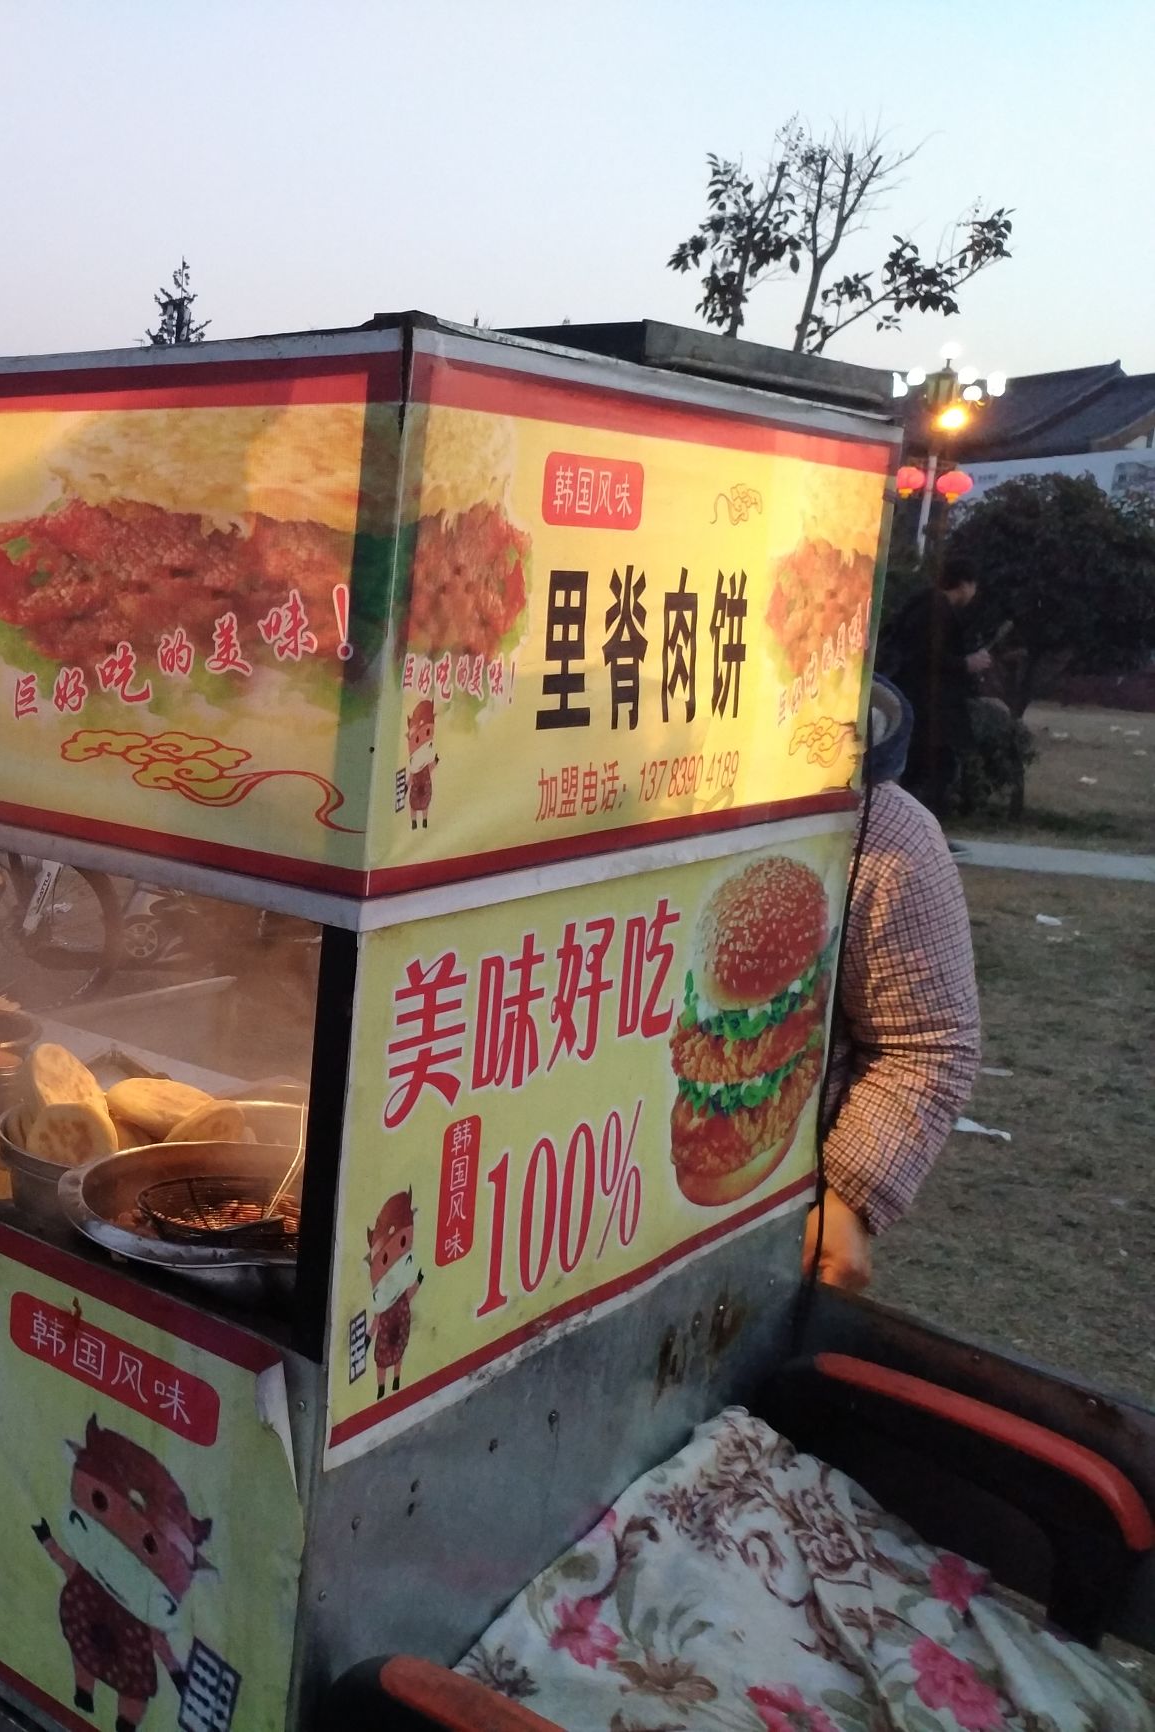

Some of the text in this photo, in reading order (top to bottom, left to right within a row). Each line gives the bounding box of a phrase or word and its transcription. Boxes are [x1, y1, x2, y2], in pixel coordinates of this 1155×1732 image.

[552, 465, 633, 518] 韩国风味
[535, 564, 748, 731] 里脊肉饼
[637, 759, 668, 802] 137
[666, 755, 704, 799] 8390
[705, 750, 740, 791] 4189
[383, 898, 681, 1129] 美味好吃
[444, 1119, 472, 1260] 韩国风味
[476, 1100, 644, 1319] 100%
[29, 1309, 192, 1426] 韩国风味
